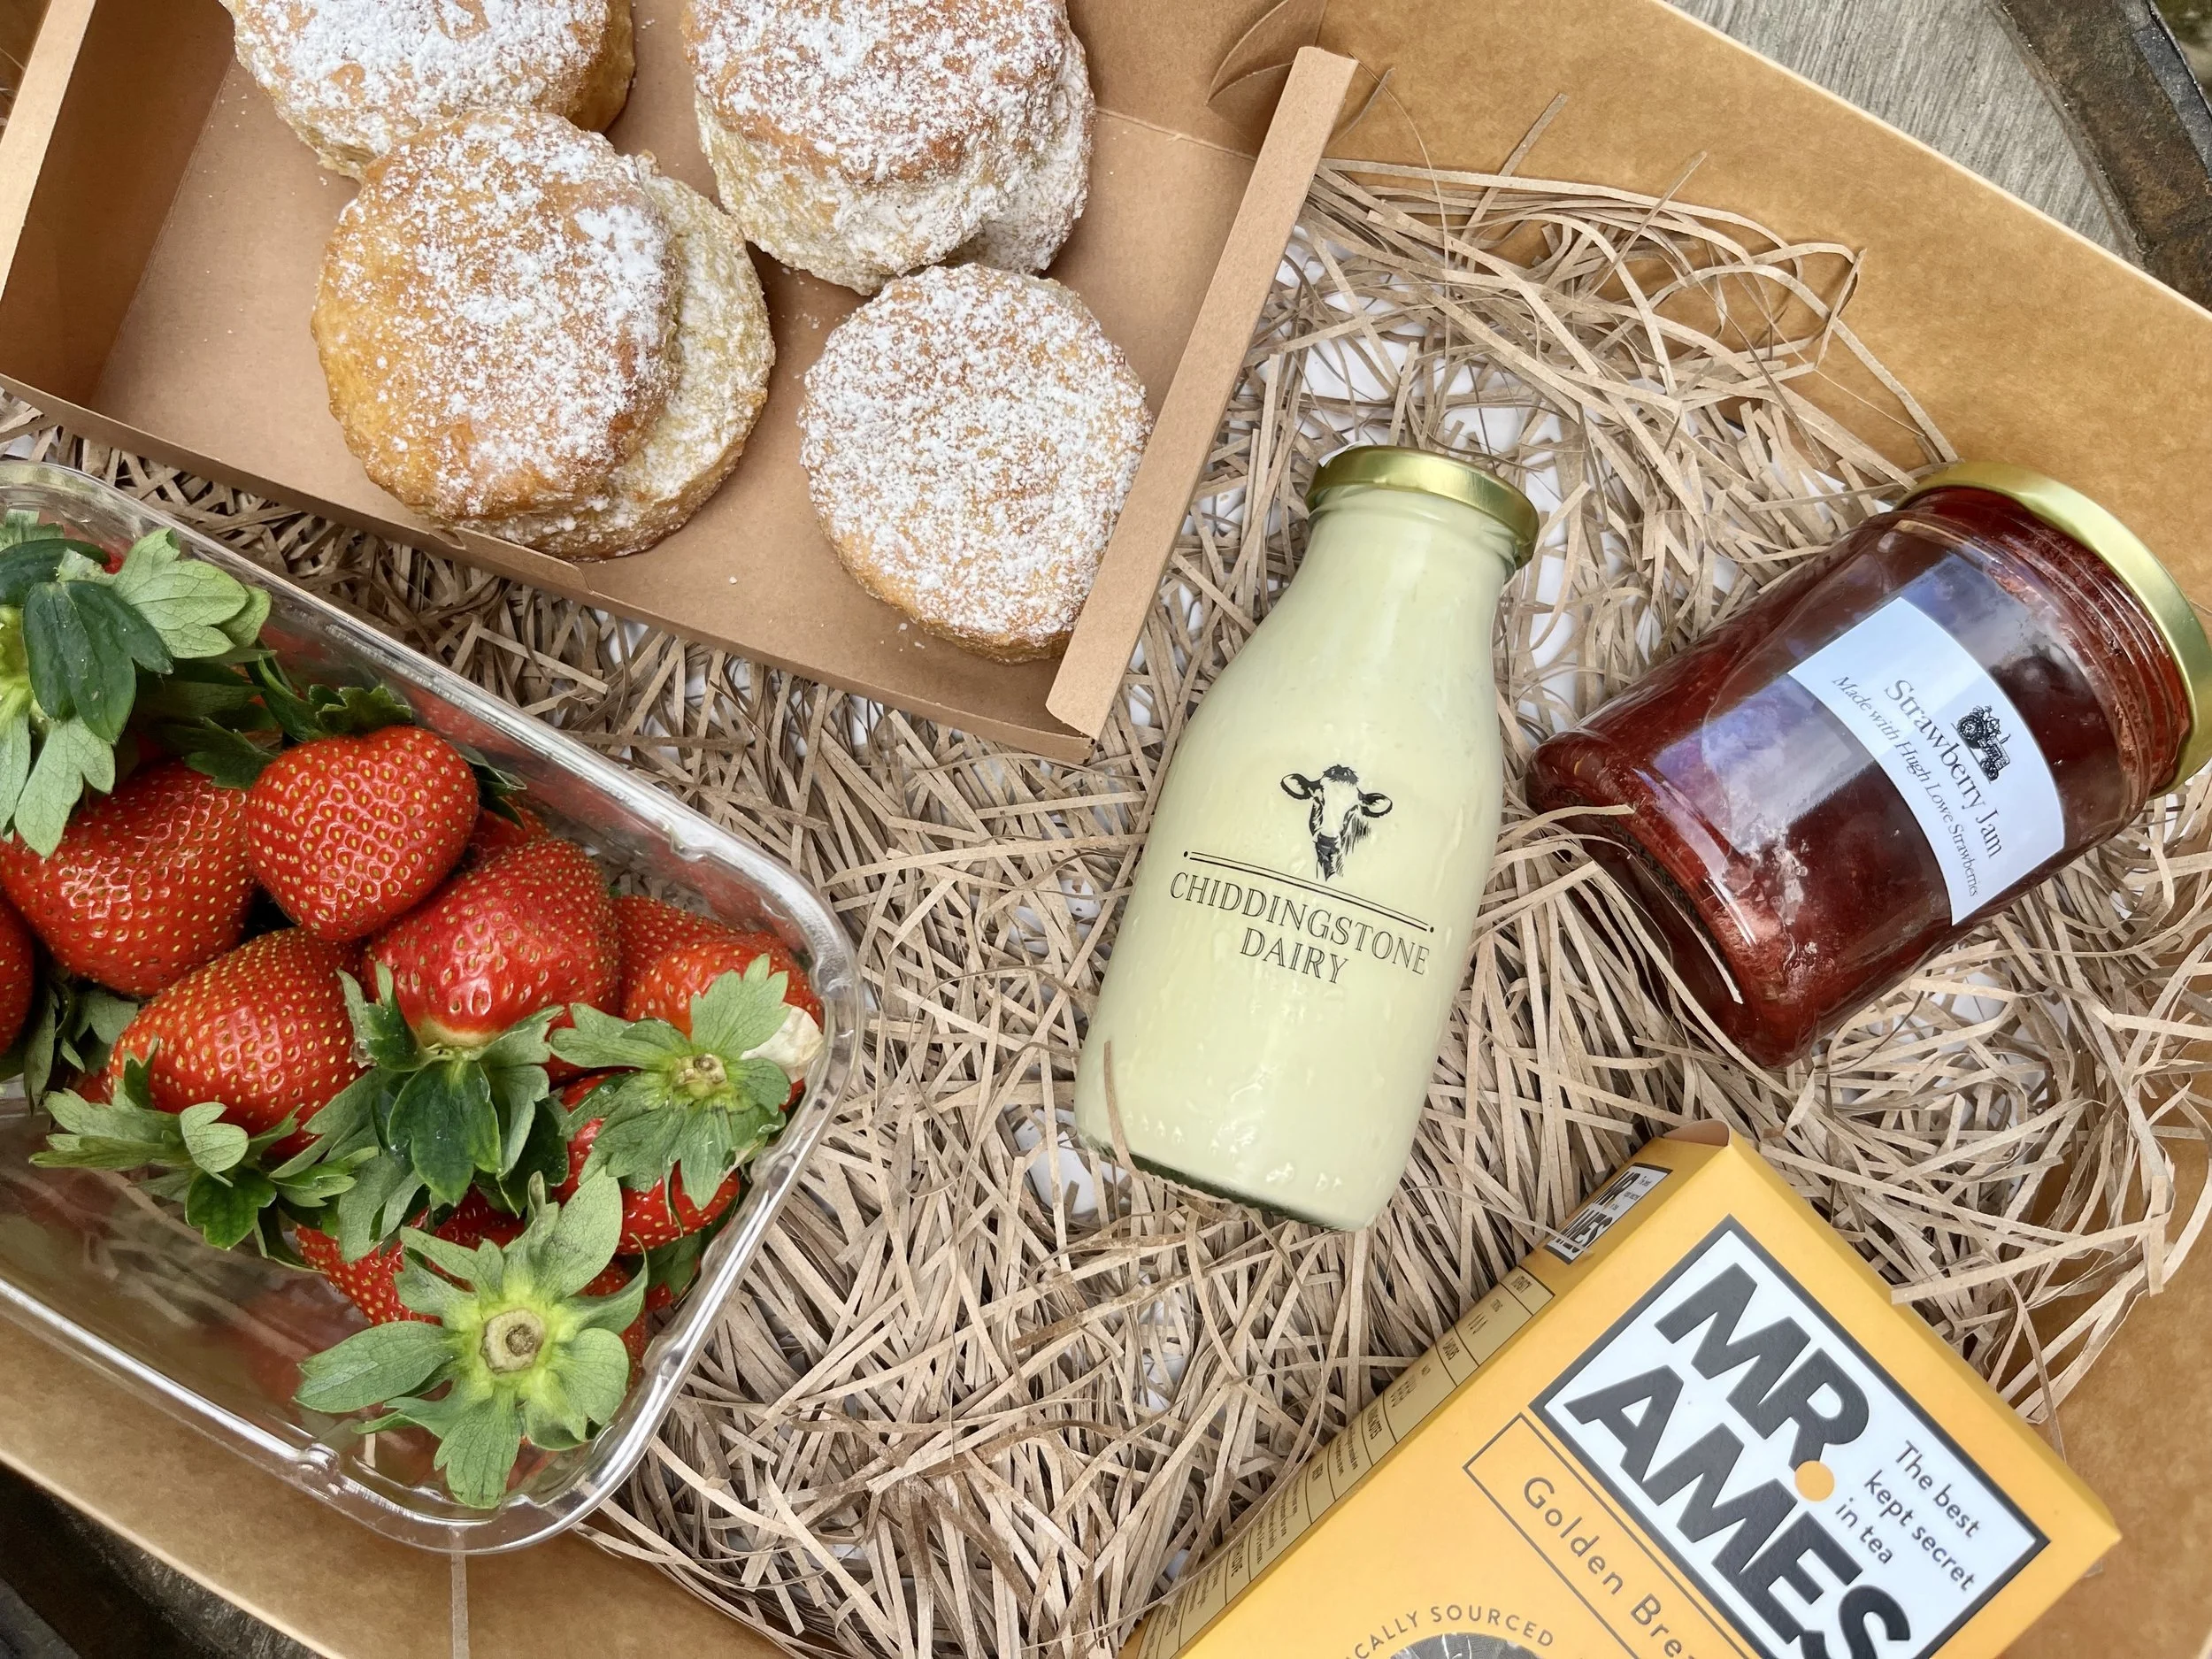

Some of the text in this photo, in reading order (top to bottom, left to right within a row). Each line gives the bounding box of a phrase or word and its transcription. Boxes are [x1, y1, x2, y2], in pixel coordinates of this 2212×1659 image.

[1832, 676, 1978, 897] Made with Hugh Lowe Strawberries
[1885, 680, 2003, 859] Strawberry Jam
[1169, 872, 1431, 976] CHIDDINGSTONE
[1239, 926, 1349, 984] DAIRY
[1563, 1363, 1912, 1659] AMES
[1835, 1497, 1893, 1564] in tea
[1863, 1469, 1976, 1592] kept secret
[1895, 1440, 1980, 1539] The best
[1524, 1476, 1697, 1659] Golden Bre
[1346, 1604, 1555, 1659] CALLY SOURCED
